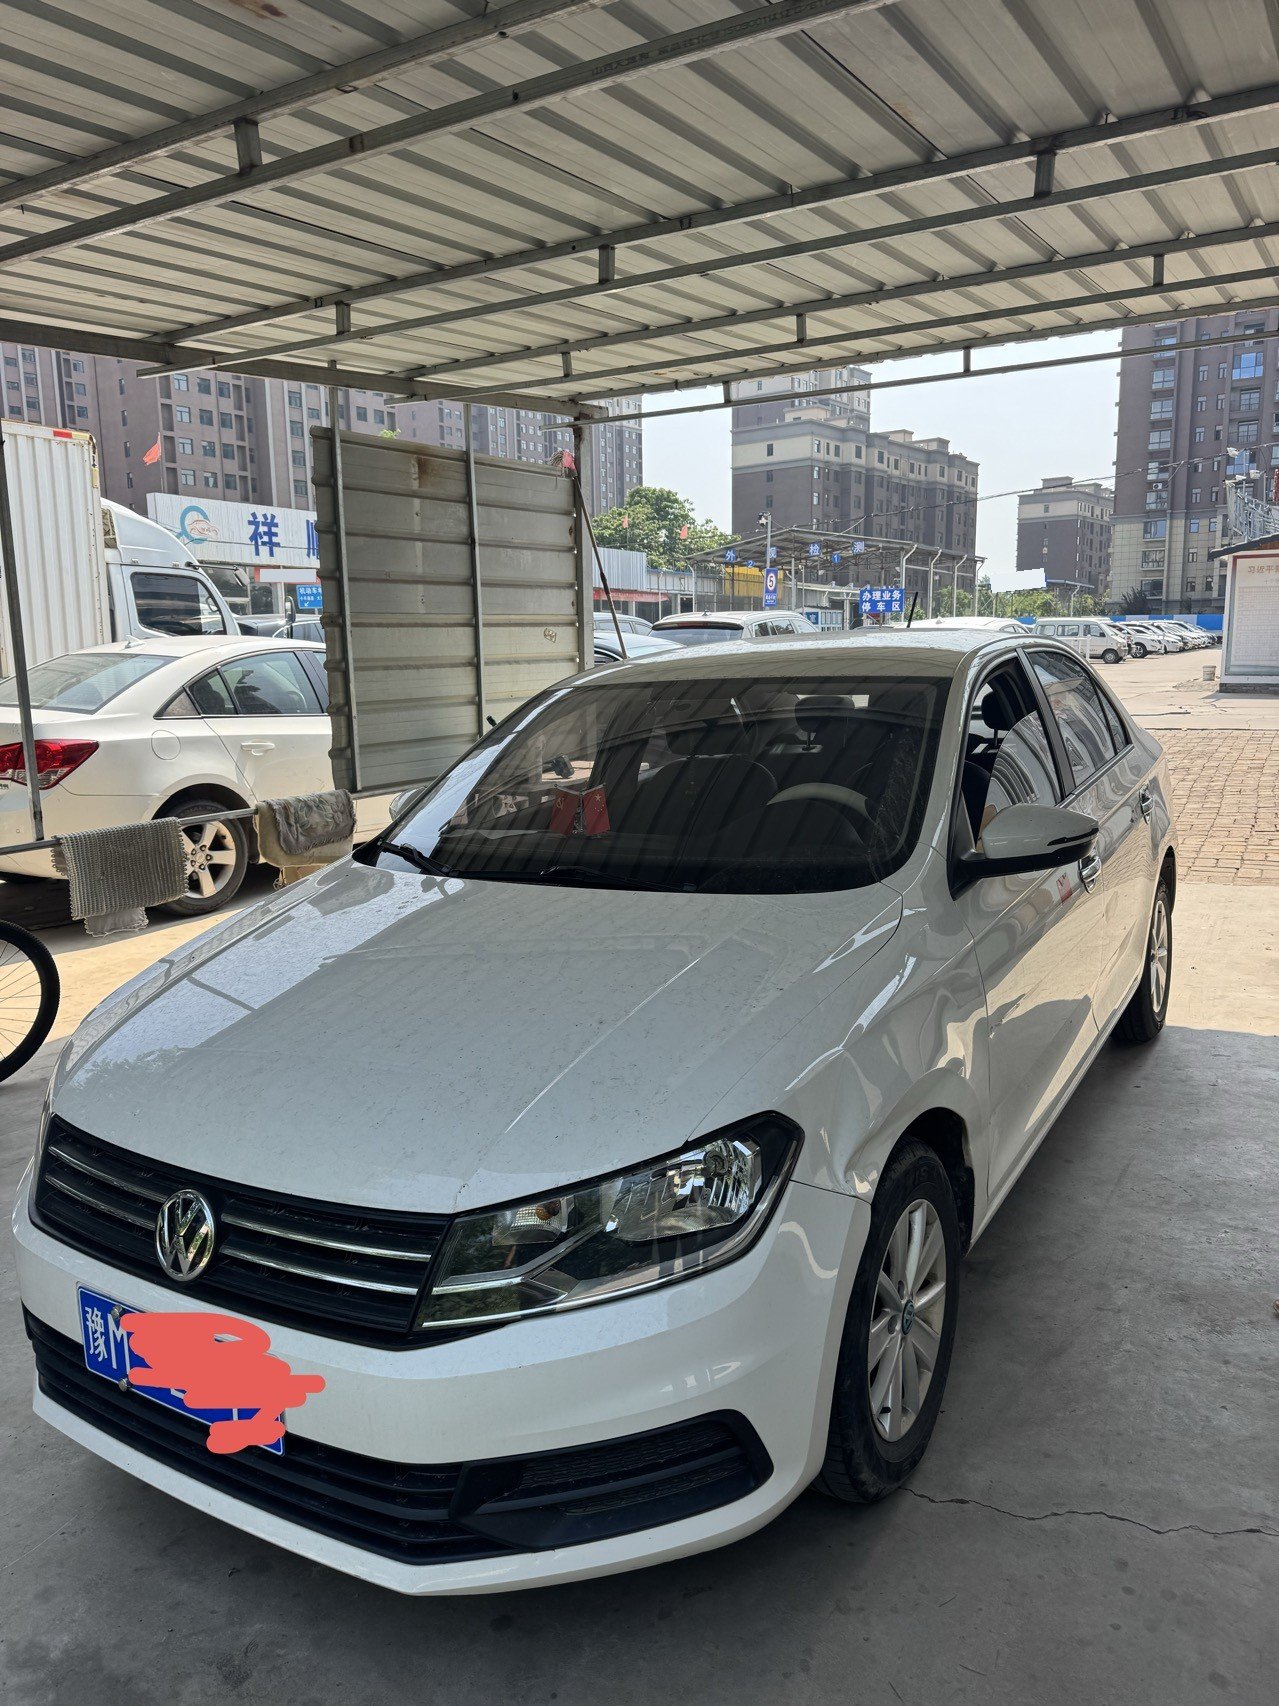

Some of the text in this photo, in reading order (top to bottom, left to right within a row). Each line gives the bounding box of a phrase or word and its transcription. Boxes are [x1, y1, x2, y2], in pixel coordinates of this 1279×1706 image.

[768, 575, 774, 588] 5
[862, 590, 902, 601] 办理业务
[862, 601, 901, 612] 停车区
